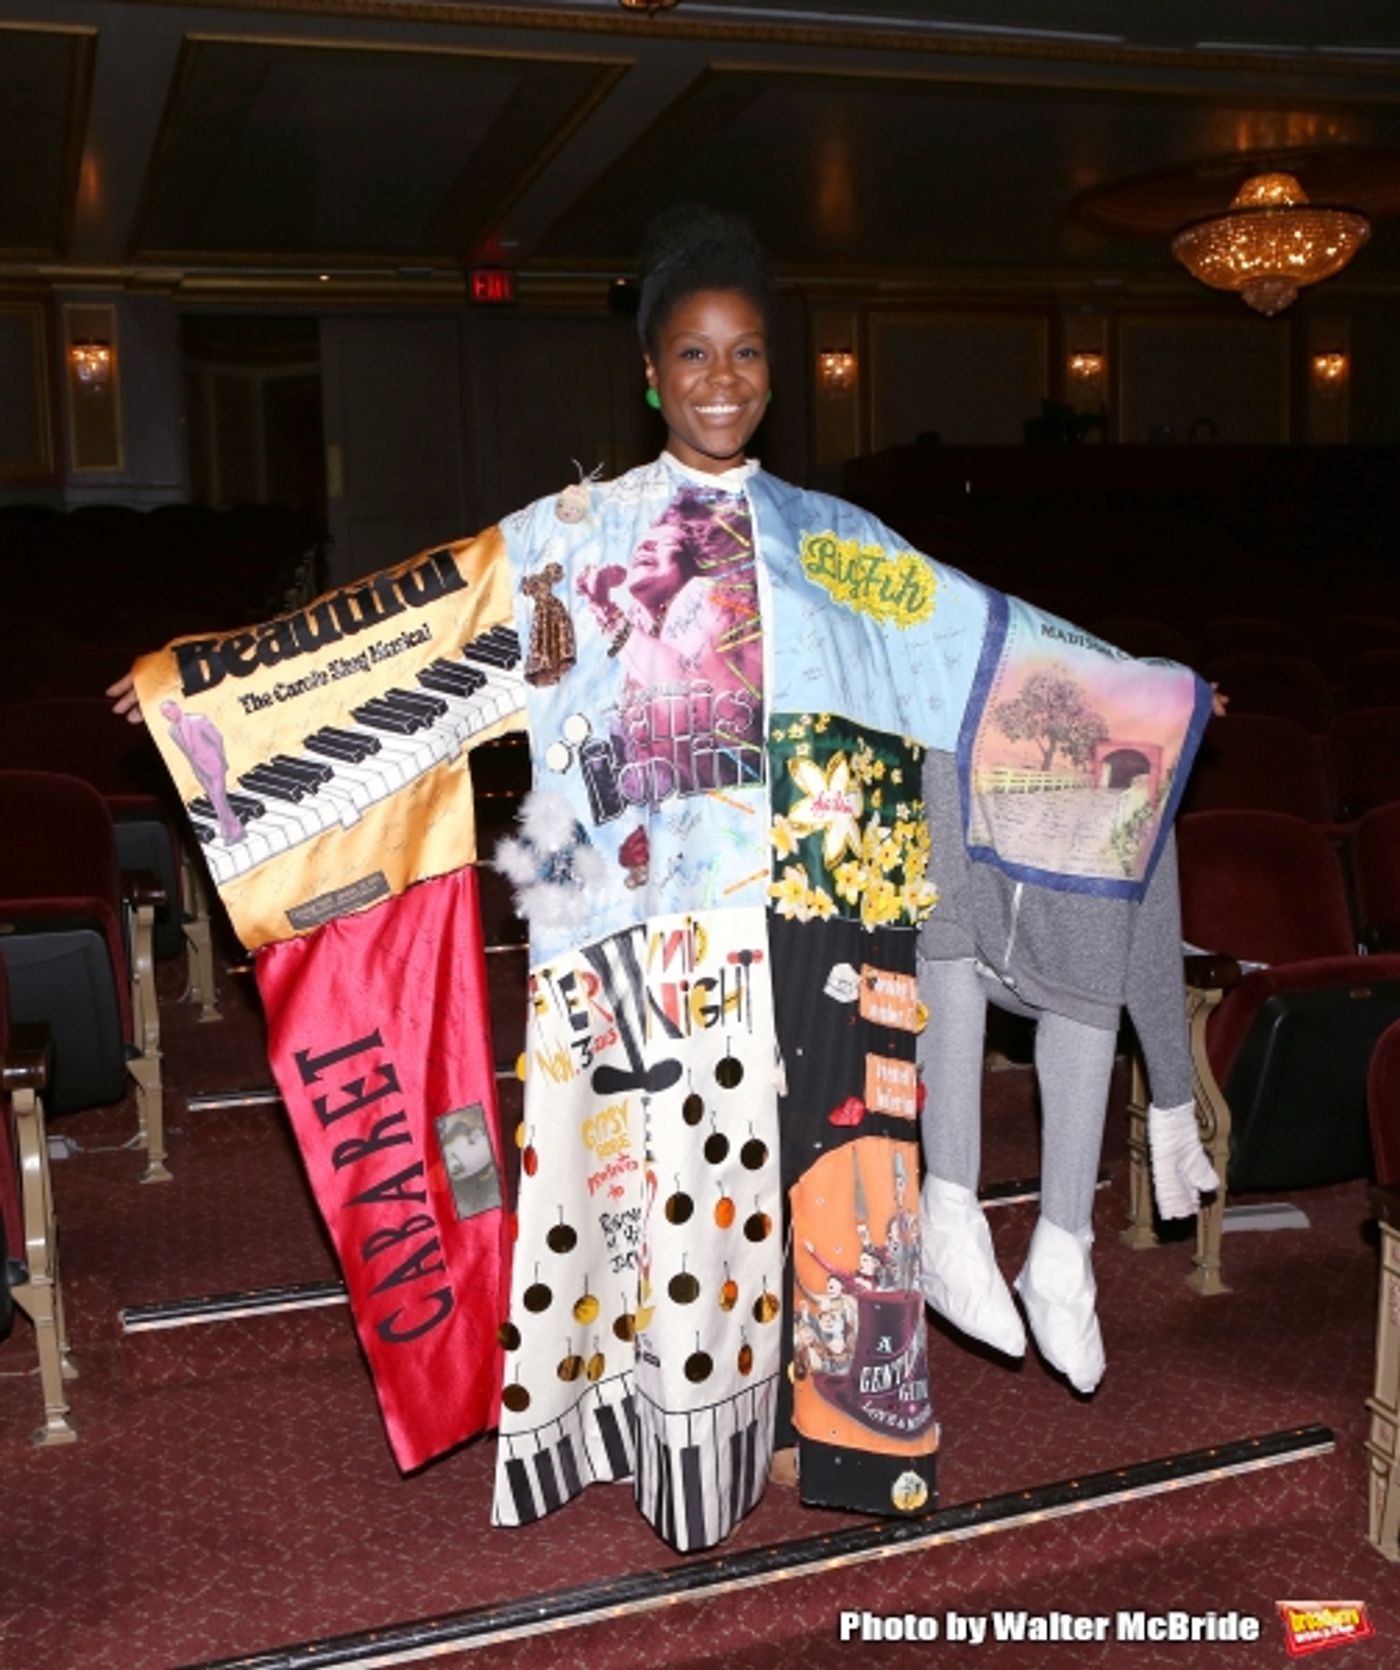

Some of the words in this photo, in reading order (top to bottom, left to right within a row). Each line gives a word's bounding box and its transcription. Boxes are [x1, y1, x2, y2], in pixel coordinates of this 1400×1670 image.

[171, 549, 469, 698] Beautiful
[238, 692, 274, 715] The
[294, 1027, 455, 1344] CABARET
